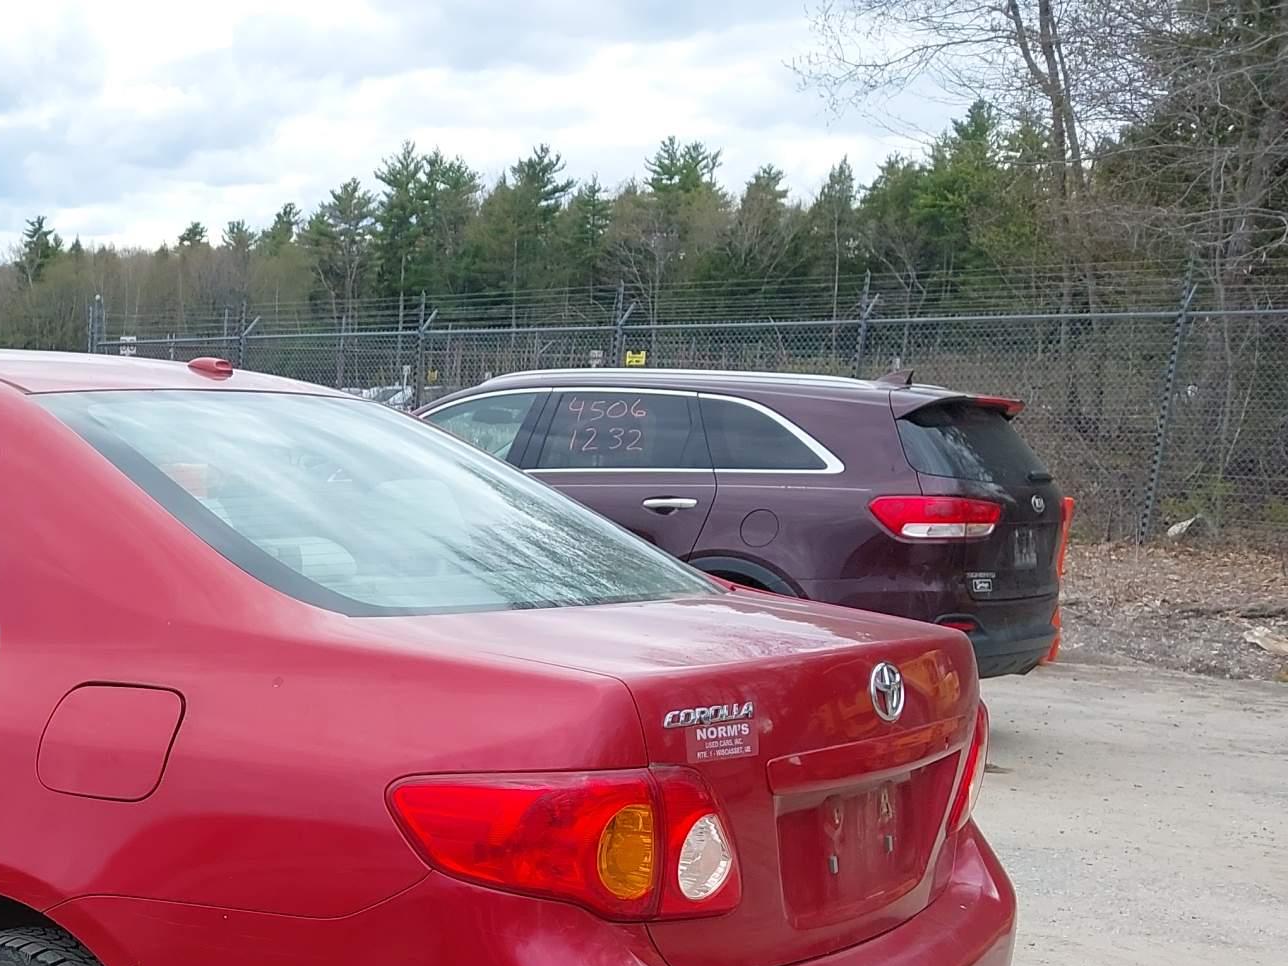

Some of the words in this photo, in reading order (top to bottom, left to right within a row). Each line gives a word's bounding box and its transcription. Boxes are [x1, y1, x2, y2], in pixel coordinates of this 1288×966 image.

[569, 397, 647, 421] 4506
[664, 702, 754, 729] COROLLA
[696, 723, 750, 741] NORM'S
